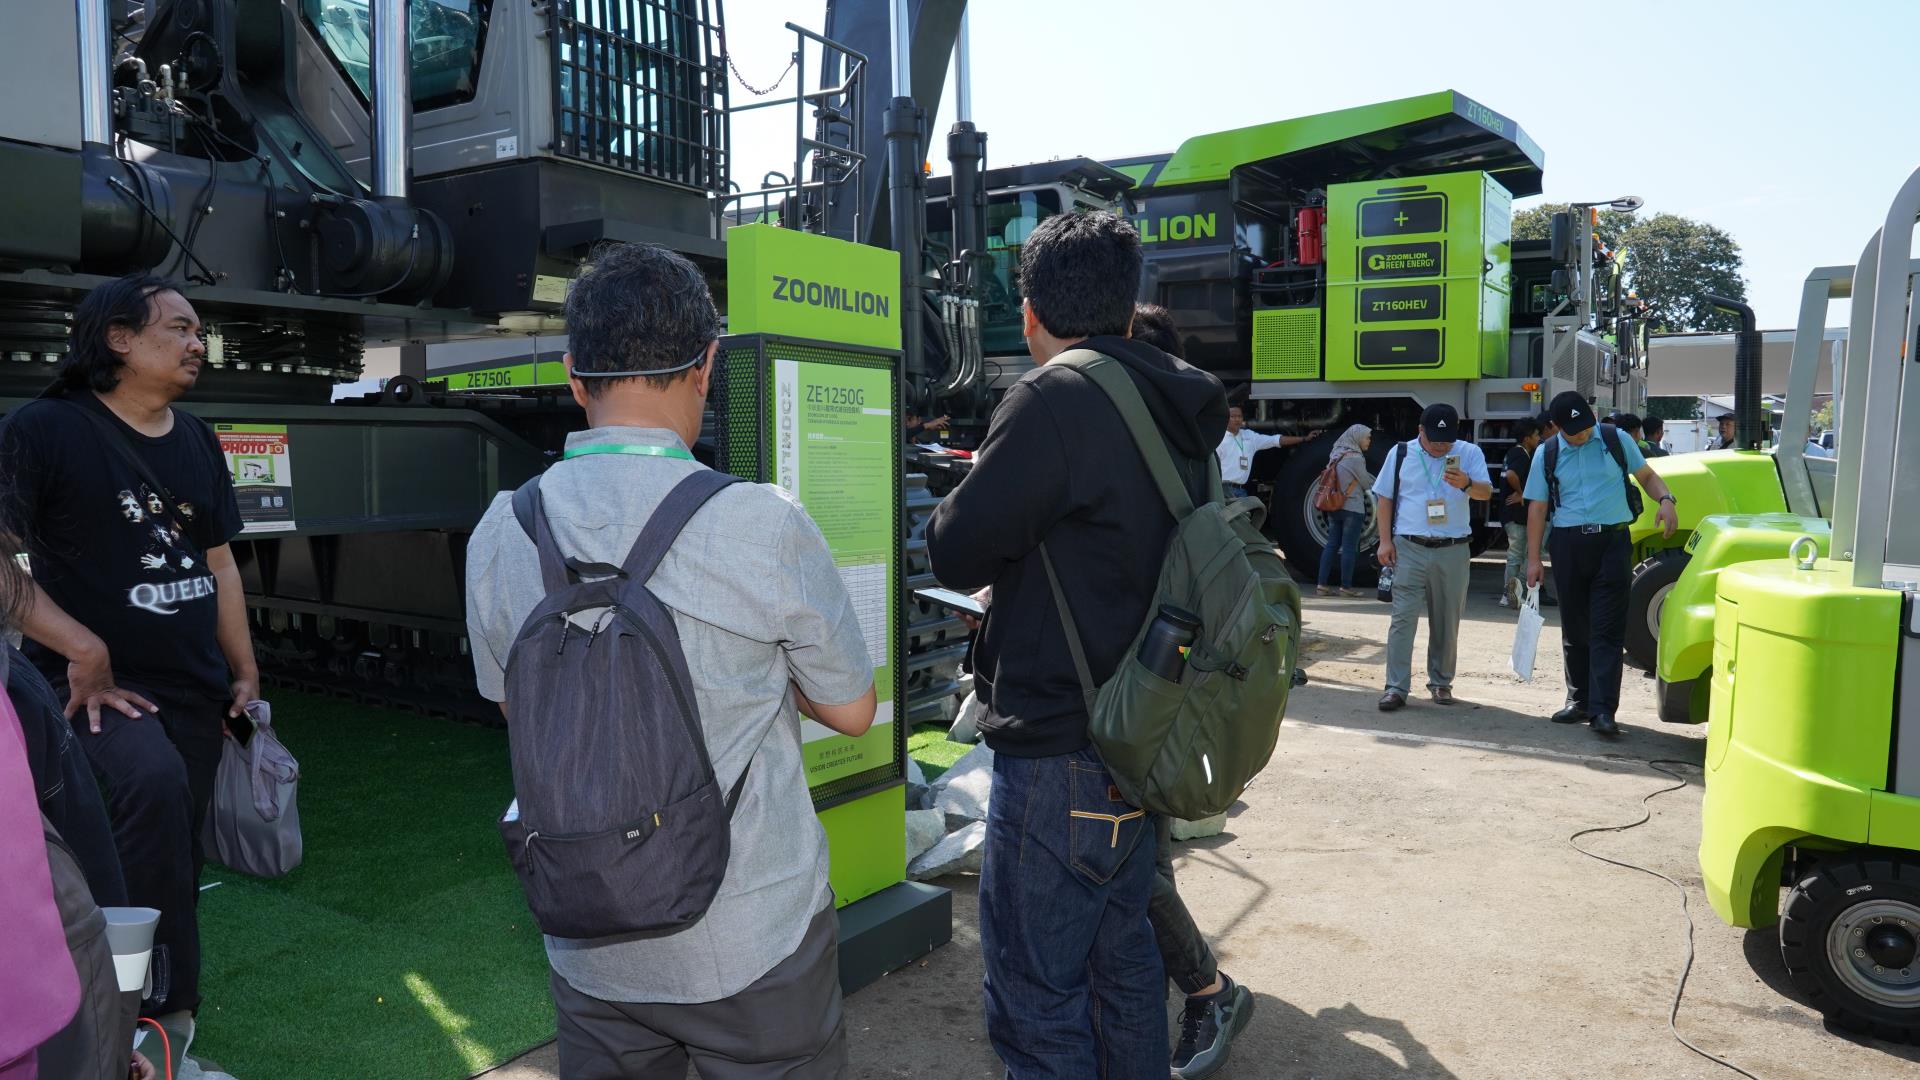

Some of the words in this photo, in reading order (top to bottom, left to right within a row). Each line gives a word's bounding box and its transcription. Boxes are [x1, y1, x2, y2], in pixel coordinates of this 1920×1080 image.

[1134, 212, 1216, 243] LION
[1386, 252, 1428, 261] ZOOMLION
[1407, 258, 1435, 268] ENERGY
[772, 275, 889, 318] ZOOMLION
[1372, 299, 1428, 312] ZT160HEV
[467, 370, 511, 388] ZE750G
[806, 384, 864, 406] ZE1250G
[221, 442, 267, 454] PHOTO
[129, 576, 215, 615] QUEEN
